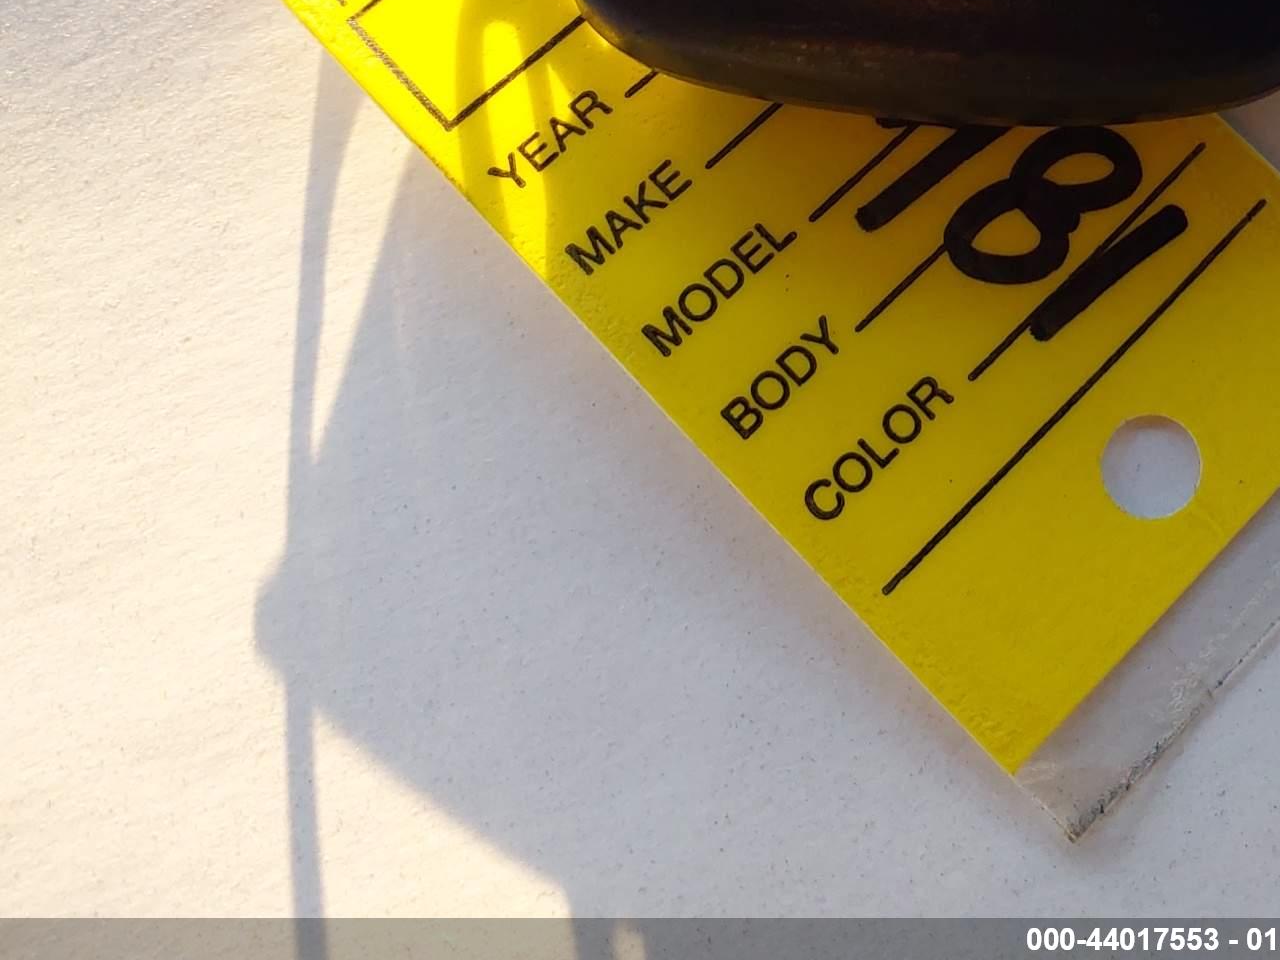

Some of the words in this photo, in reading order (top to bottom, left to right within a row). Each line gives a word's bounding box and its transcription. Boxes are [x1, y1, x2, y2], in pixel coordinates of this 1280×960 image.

[487, 87, 614, 189] YEAR
[564, 158, 693, 276] MAKE
[641, 218, 798, 357] MODEL
[720, 314, 840, 440] BODY
[804, 375, 955, 521] COLOR
